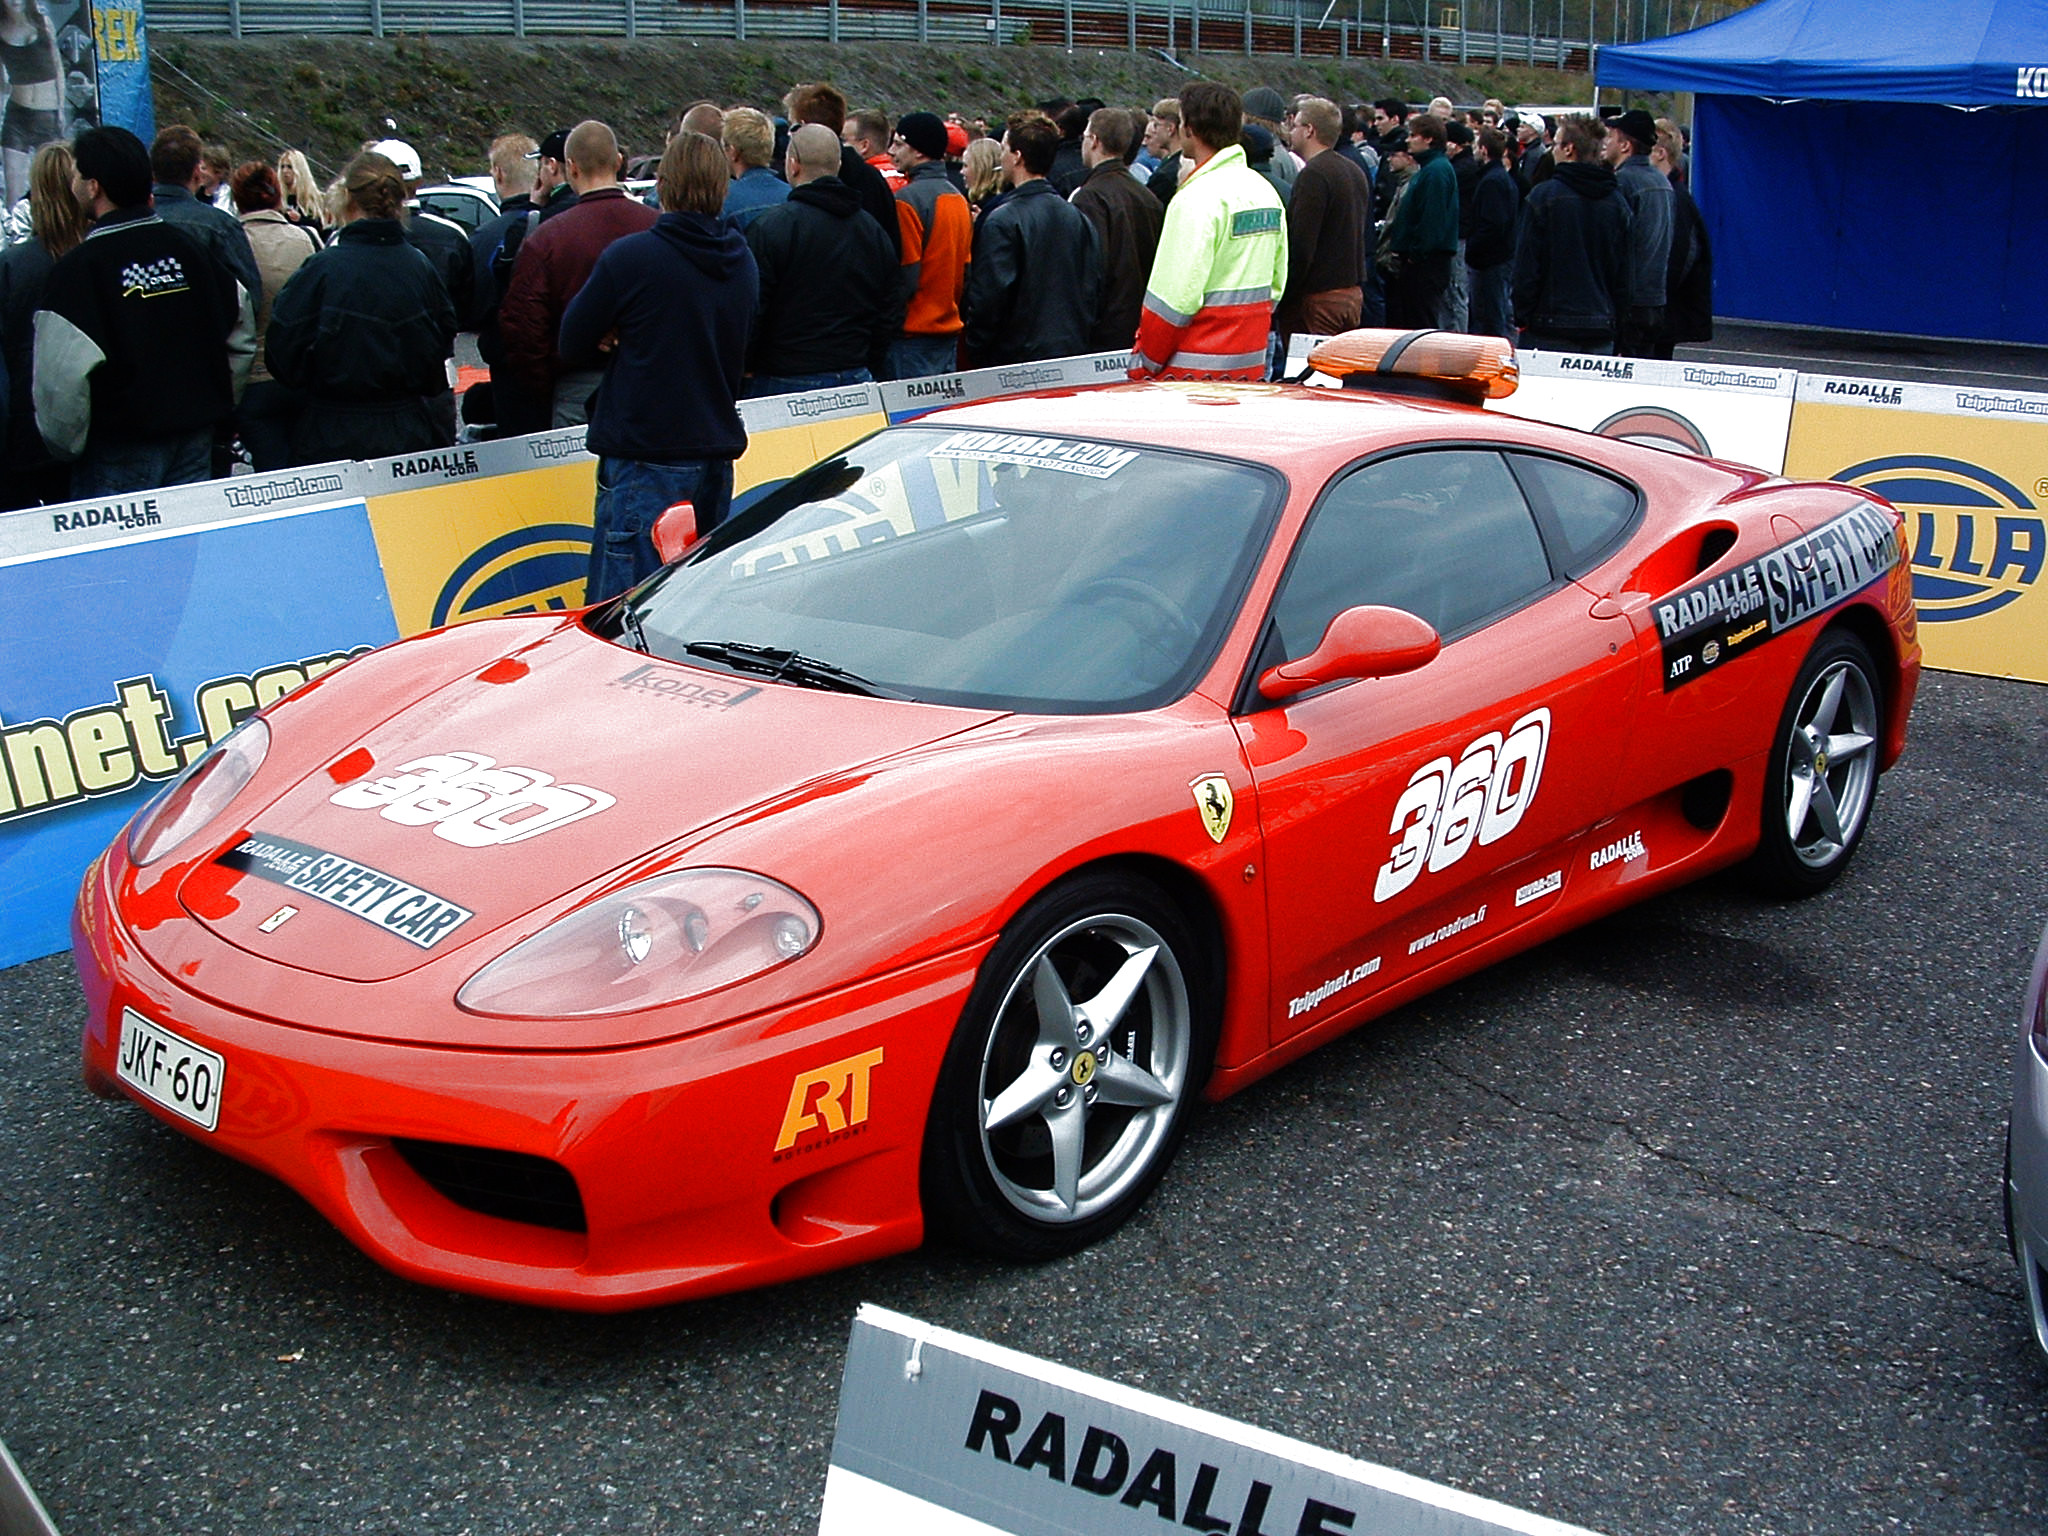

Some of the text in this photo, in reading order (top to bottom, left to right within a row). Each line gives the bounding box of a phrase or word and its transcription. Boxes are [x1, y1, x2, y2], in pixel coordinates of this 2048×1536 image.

[1094, 357, 1128, 373] RADAL
[1560, 357, 1635, 373] RADALLE
[1601, 369, 1633, 380] .com
[1684, 367, 1778, 390] Teippinet.com
[906, 378, 963, 398] RADALLE
[1824, 381, 1903, 398] RADALLE
[1869, 394, 1902, 405] .com
[787, 391, 870, 417] Teippinet.com
[529, 435, 587, 459] Teippine
[945, 432, 1140, 469] KOVAA-COM
[391, 451, 476, 479] RADALLE
[444, 463, 479, 479] .com
[225, 475, 343, 507] Teippinet.com
[53, 499, 158, 533] RADALLE
[118, 513, 162, 531] .com
[1898, 509, 2047, 586] LLA
[1765, 506, 1899, 625] SAFETY CAR
[1658, 564, 1760, 638] RADALLE
[1725, 588, 1764, 623] .com
[1670, 654, 1693, 679] ATP
[328, 750, 618, 849] 360
[1373, 706, 1552, 904] 360
[235, 839, 313, 869] RADALLE
[1590, 830, 1642, 871] RADALLE
[1623, 842, 1646, 863] .com
[263, 857, 300, 875] .com
[293, 857, 461, 944] SAFETY CAR
[1288, 956, 1382, 1020] Teippinet.com
[122, 1026, 212, 1112] JKF-60
[773, 1046, 884, 1153] ART
[771, 1123, 868, 1164] MOTORSPORT
